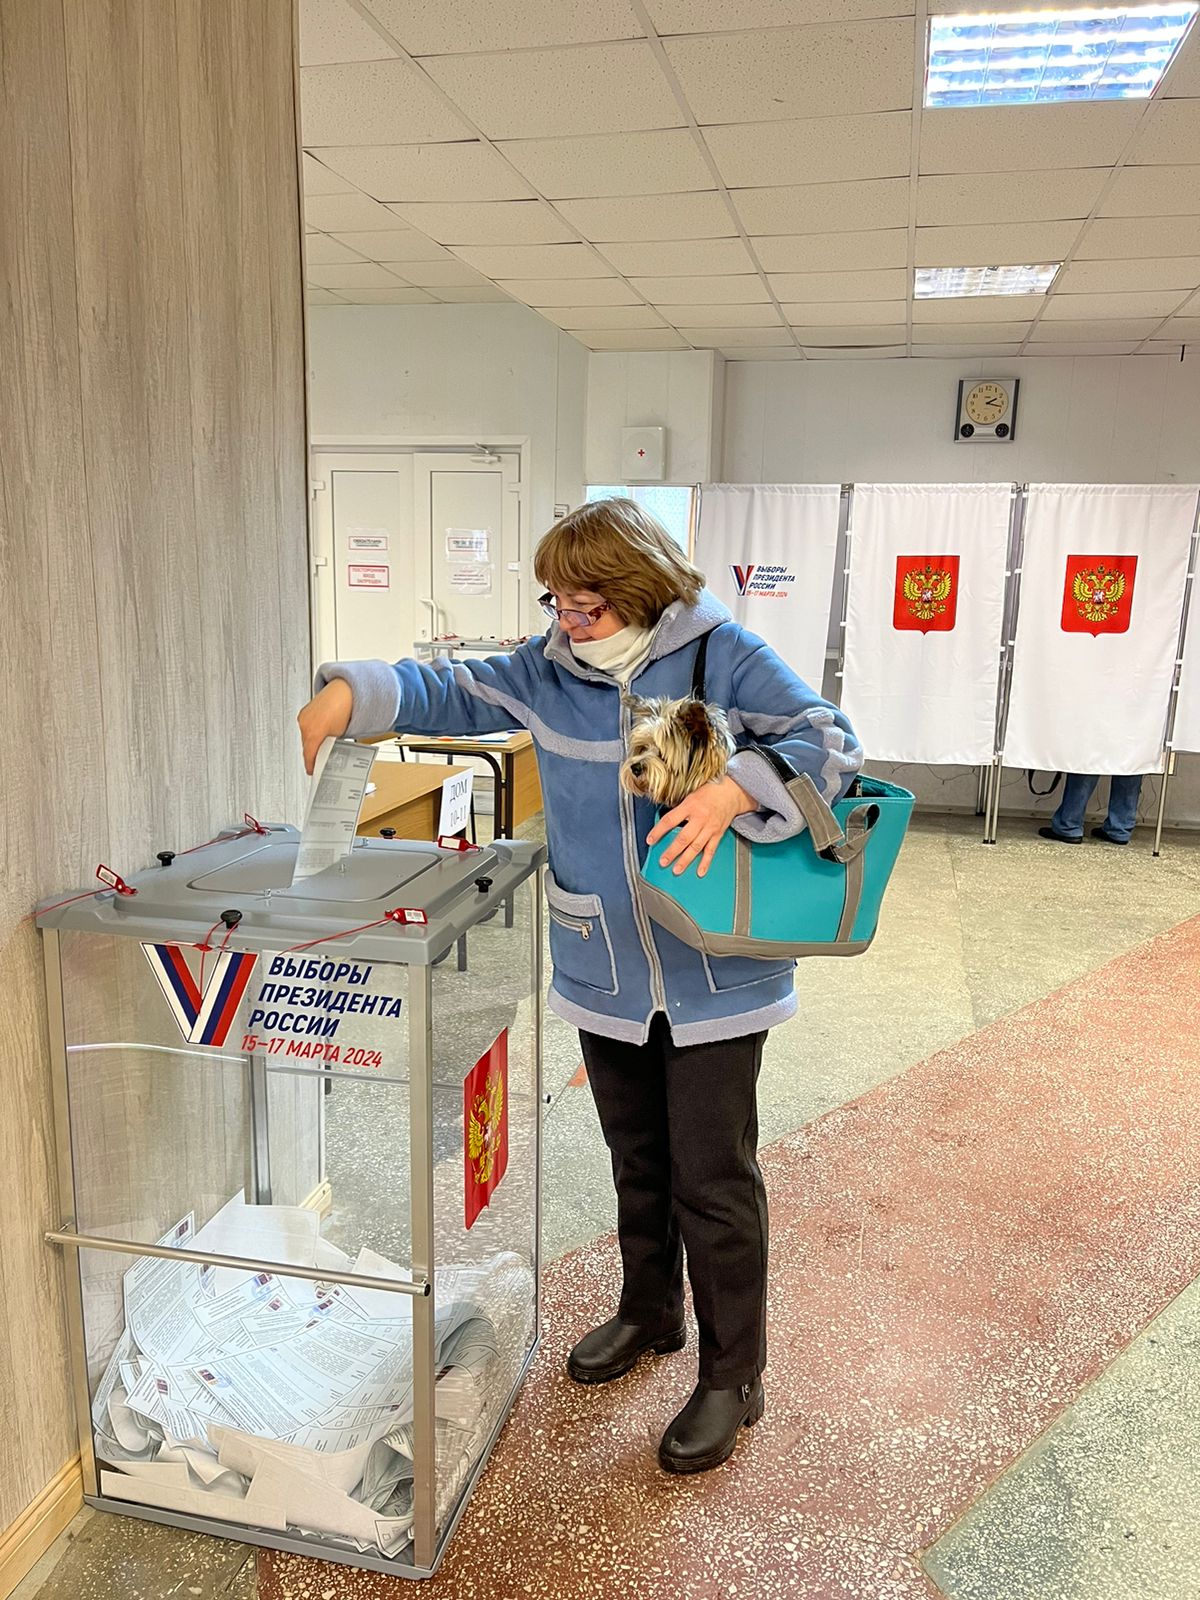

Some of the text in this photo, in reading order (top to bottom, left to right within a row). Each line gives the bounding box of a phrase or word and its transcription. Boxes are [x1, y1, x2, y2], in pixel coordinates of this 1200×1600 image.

[752, 573, 796, 583] ПРЕЗИДЕНТА
[756, 565, 788, 574] ВЫБОРЫ
[748, 582, 777, 590] РОССИИ
[449, 778, 468, 802] ДОМ
[450, 804, 467, 828] 10-11
[268, 956, 373, 986] ВЫБОРЫ
[258, 983, 403, 1019] ПРЕЗИДЕНТА
[248, 1009, 341, 1038] РОССИИ
[285, 1039, 340, 1064] МАРТА
[342, 1047, 383, 1069] 2024
